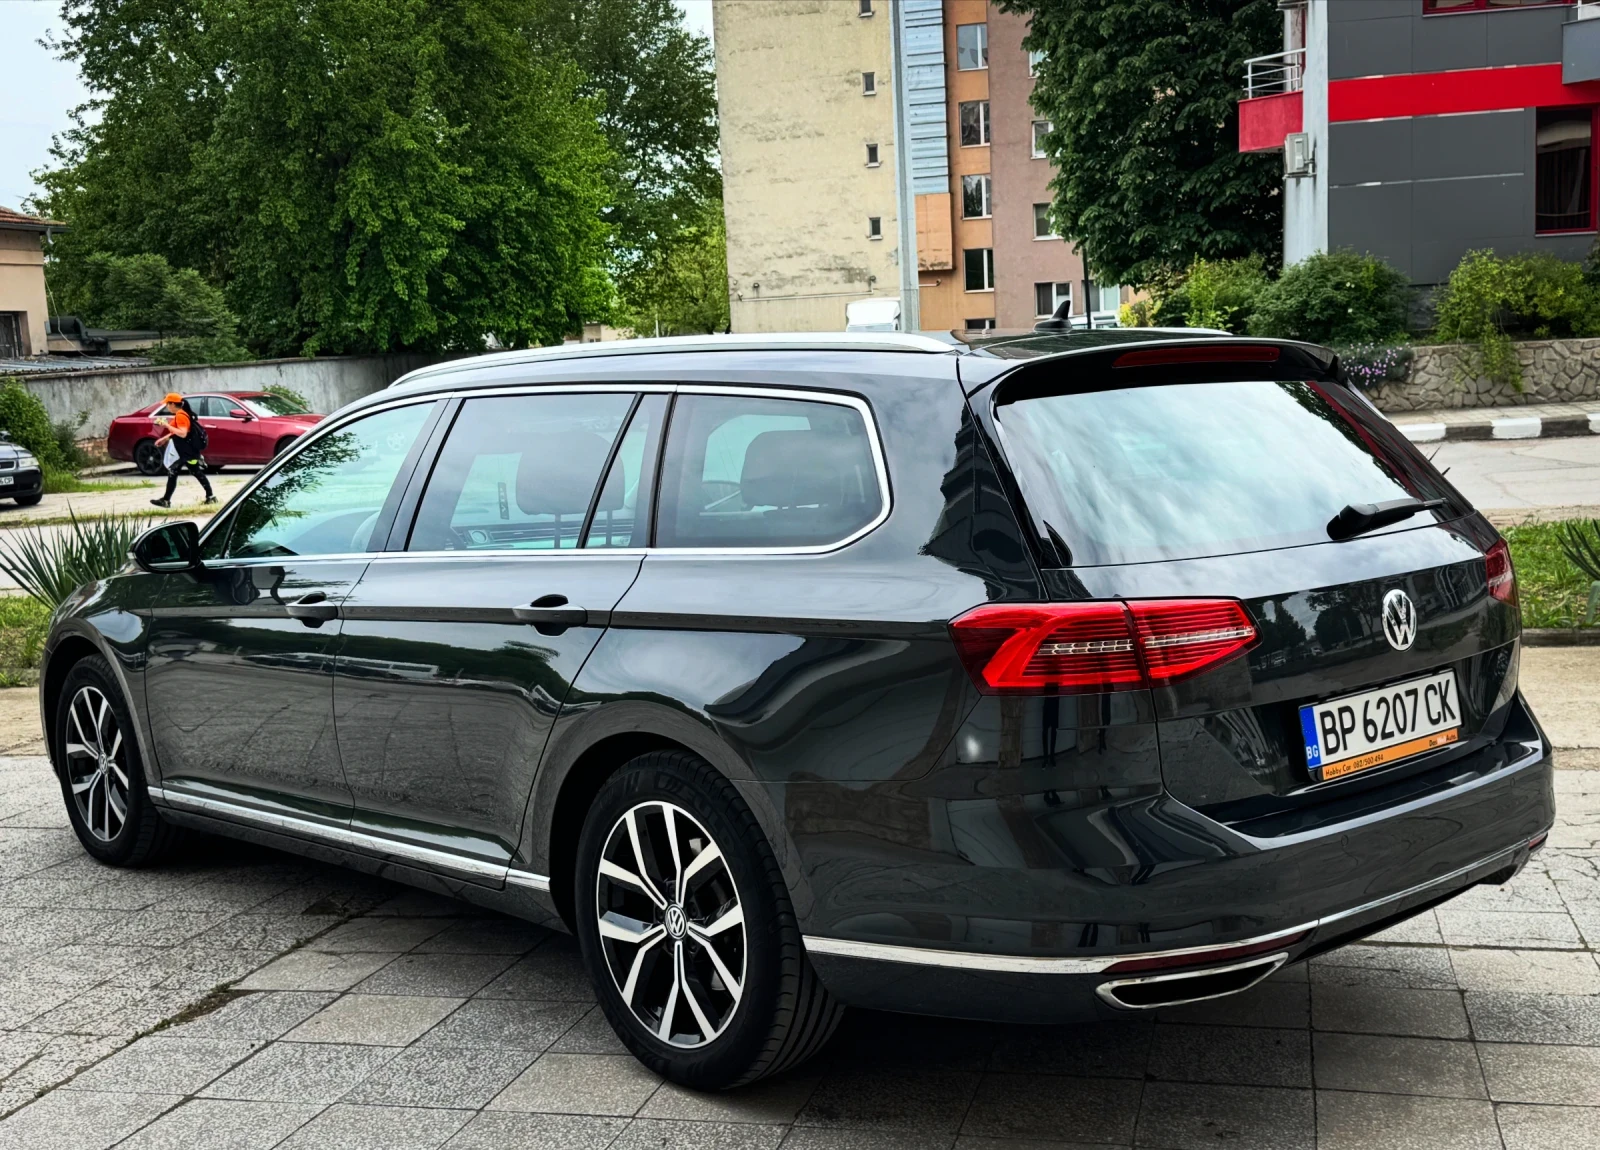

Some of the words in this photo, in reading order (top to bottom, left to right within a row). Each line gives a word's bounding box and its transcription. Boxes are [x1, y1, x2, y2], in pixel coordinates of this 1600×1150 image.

[1382, 589, 1416, 650] VW
[1320, 705, 1355, 756] BP
[1363, 688, 1418, 743] 6207
[1424, 679, 1456, 726] CK
[1306, 746, 1318, 759] BG
[1325, 766, 1341, 777] Hobby
[1342, 764, 1351, 772] Car
[666, 904, 687, 939] VW
